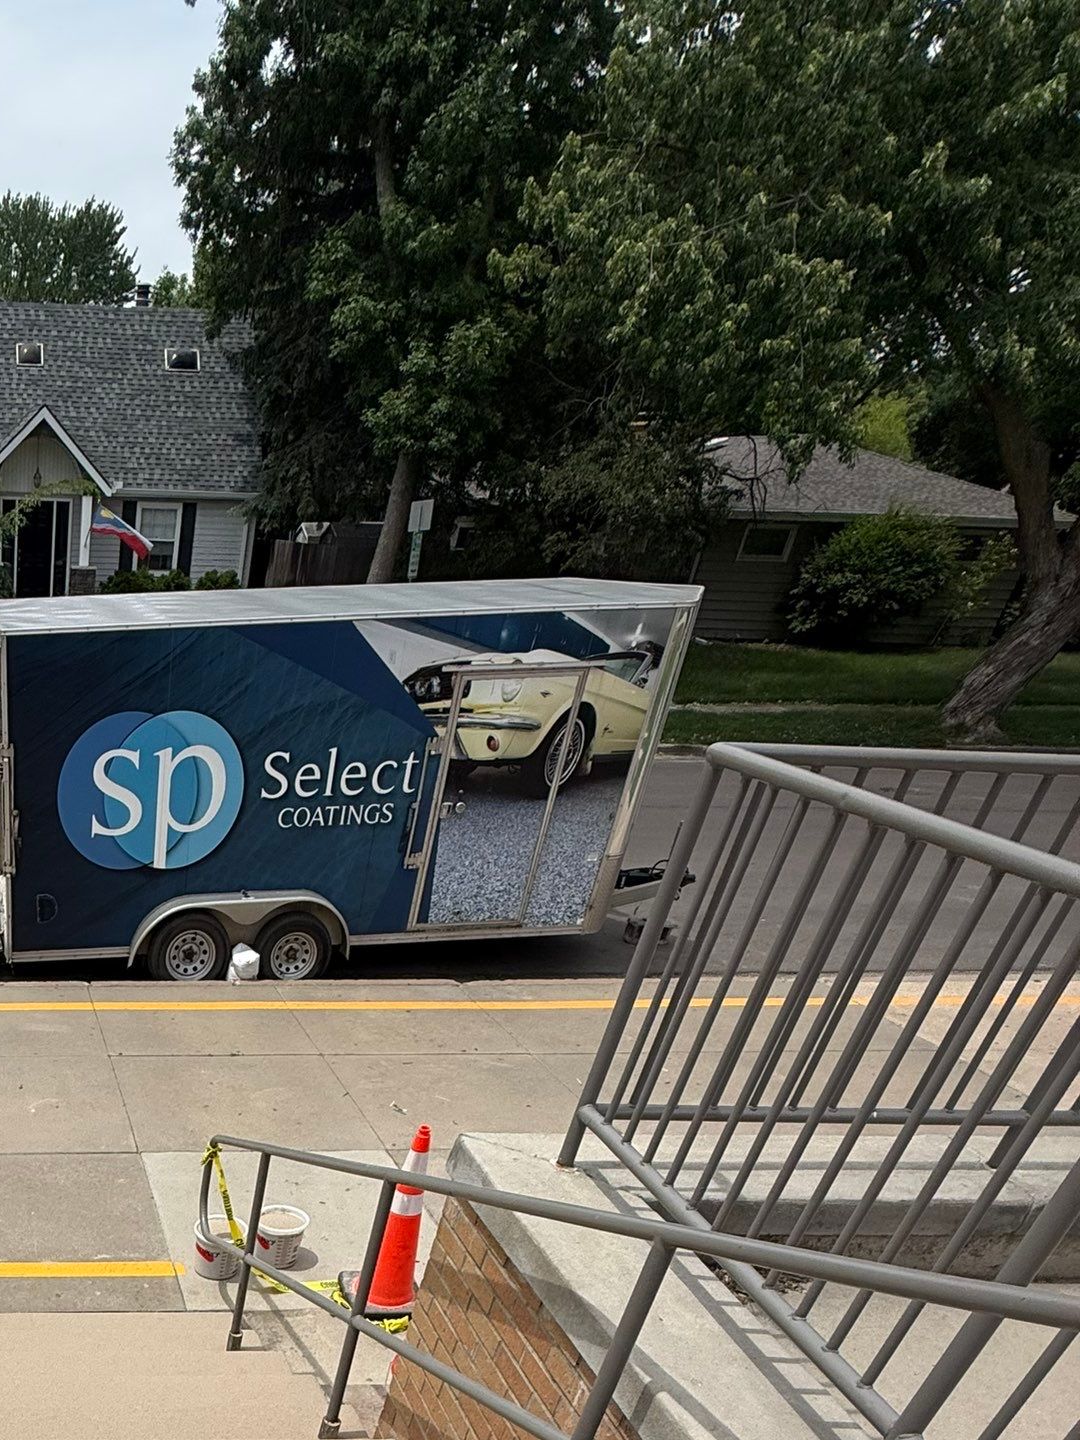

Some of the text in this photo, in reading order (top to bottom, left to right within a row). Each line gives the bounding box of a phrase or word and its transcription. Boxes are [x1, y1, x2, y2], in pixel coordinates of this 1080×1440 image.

[261, 747, 420, 799] Select
[91, 745, 227, 869] sp
[277, 803, 395, 829] COATINGS
